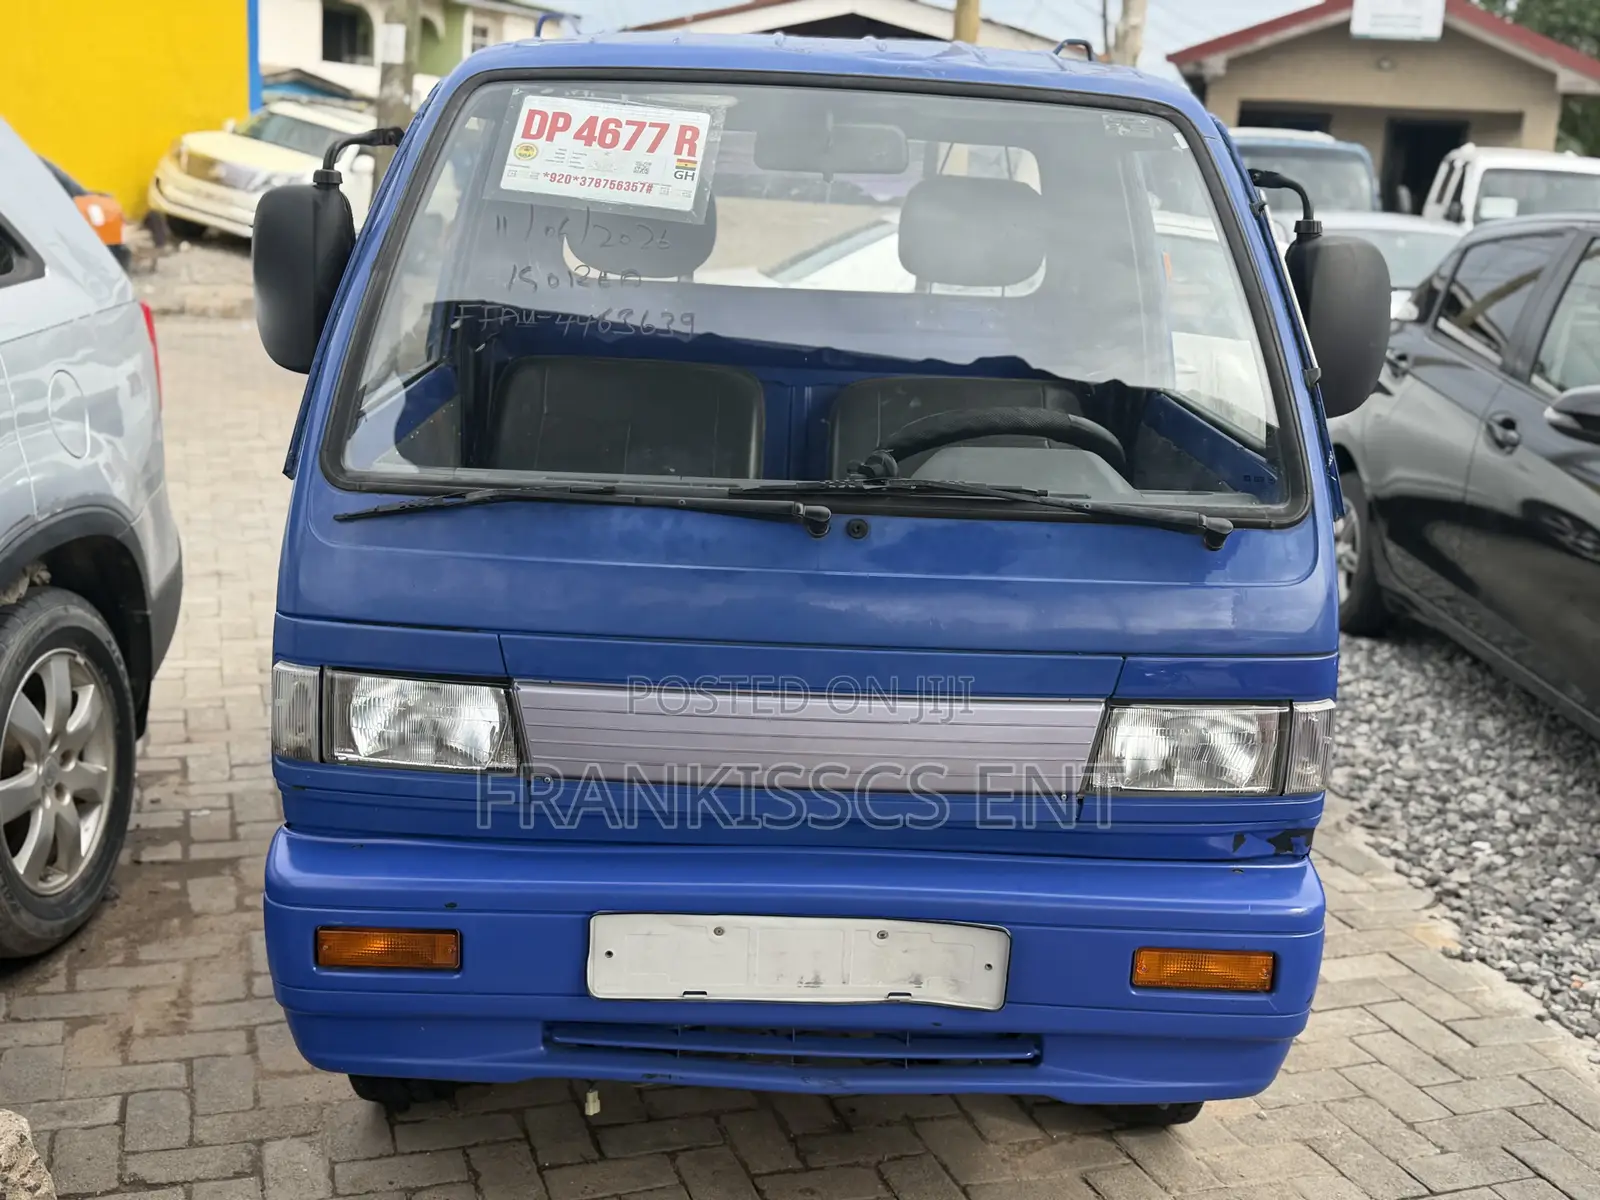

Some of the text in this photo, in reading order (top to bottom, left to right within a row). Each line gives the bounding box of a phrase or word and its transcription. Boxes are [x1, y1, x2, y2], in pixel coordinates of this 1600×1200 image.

[521, 108, 572, 142] DP
[572, 115, 670, 153] 4677
[673, 124, 700, 157] R
[673, 170, 695, 182] GH
